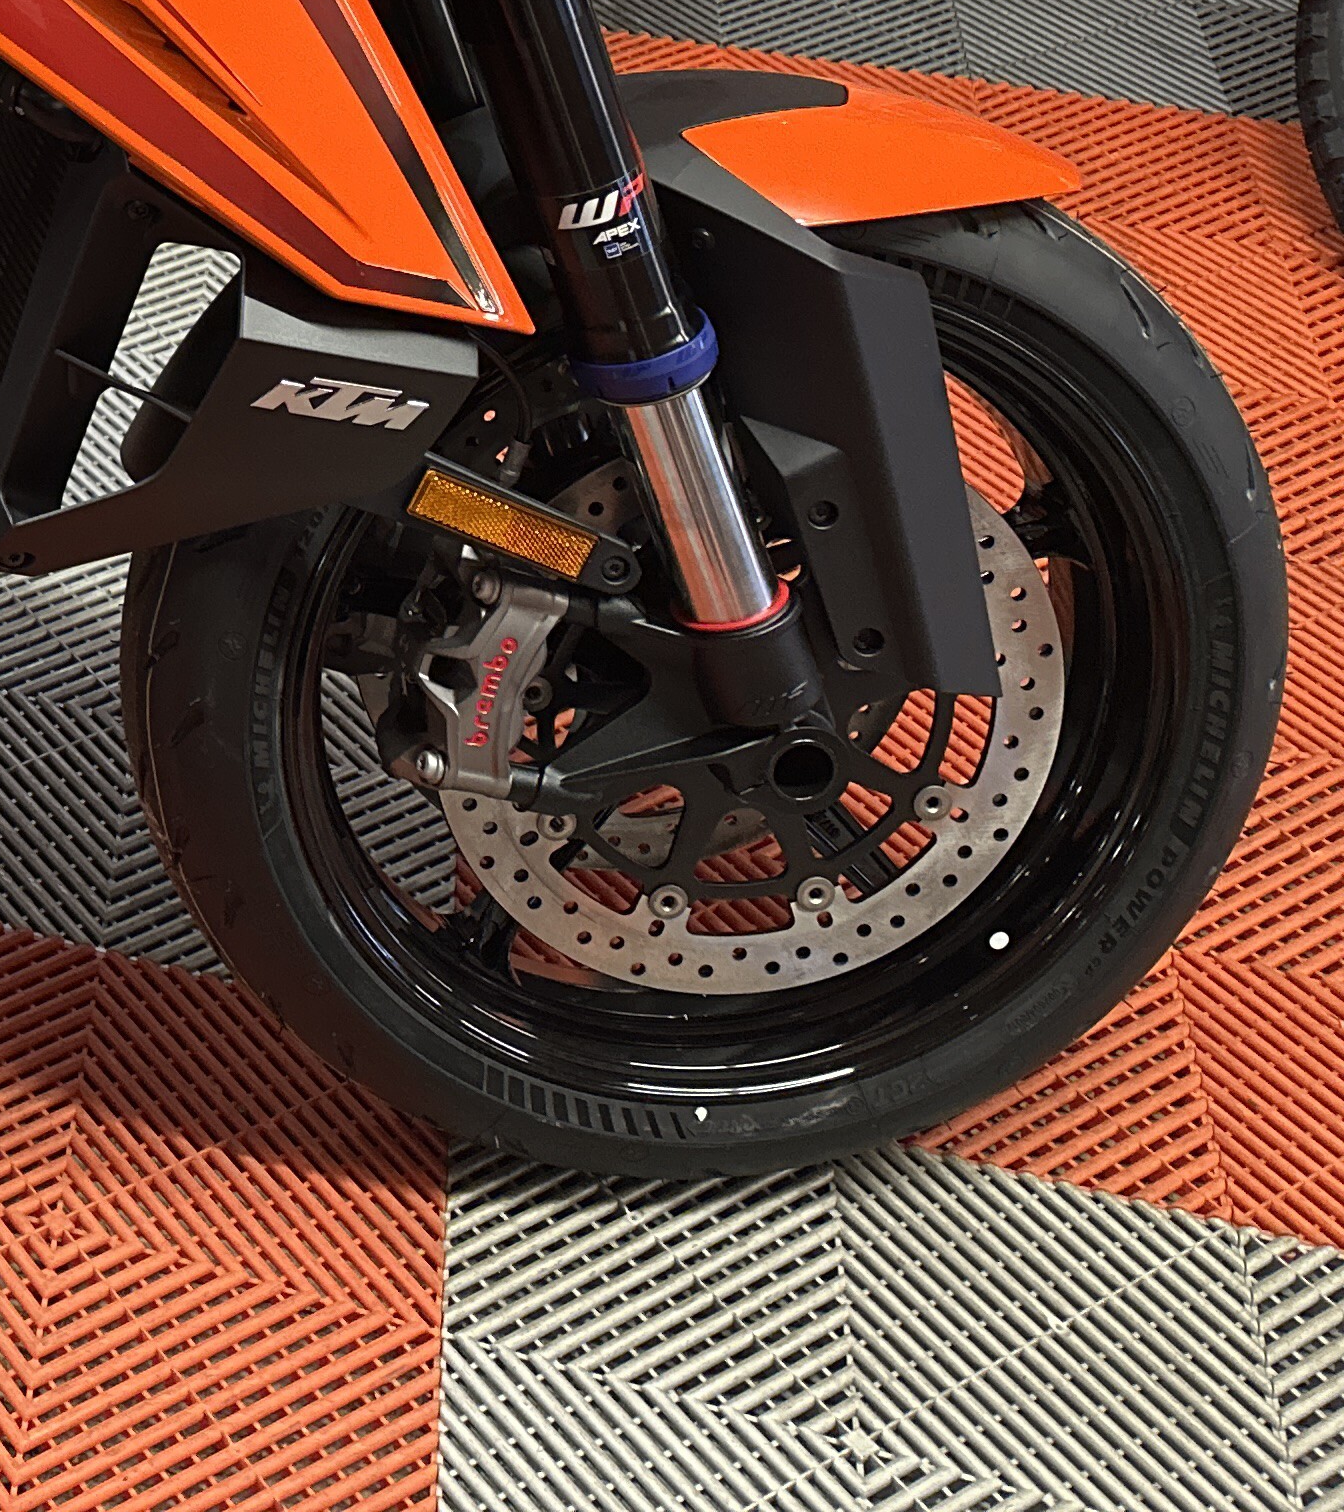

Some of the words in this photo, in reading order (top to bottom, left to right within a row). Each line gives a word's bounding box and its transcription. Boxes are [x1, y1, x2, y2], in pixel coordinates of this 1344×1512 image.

[558, 172, 644, 230] WP
[593, 217, 641, 246] APEX
[250, 376, 430, 431] KTM
[251, 585, 291, 769] MICHELIN
[464, 637, 518, 748] brembo
[1177, 638, 1236, 830] MICHELIN
[1097, 845, 1180, 955] POWER
